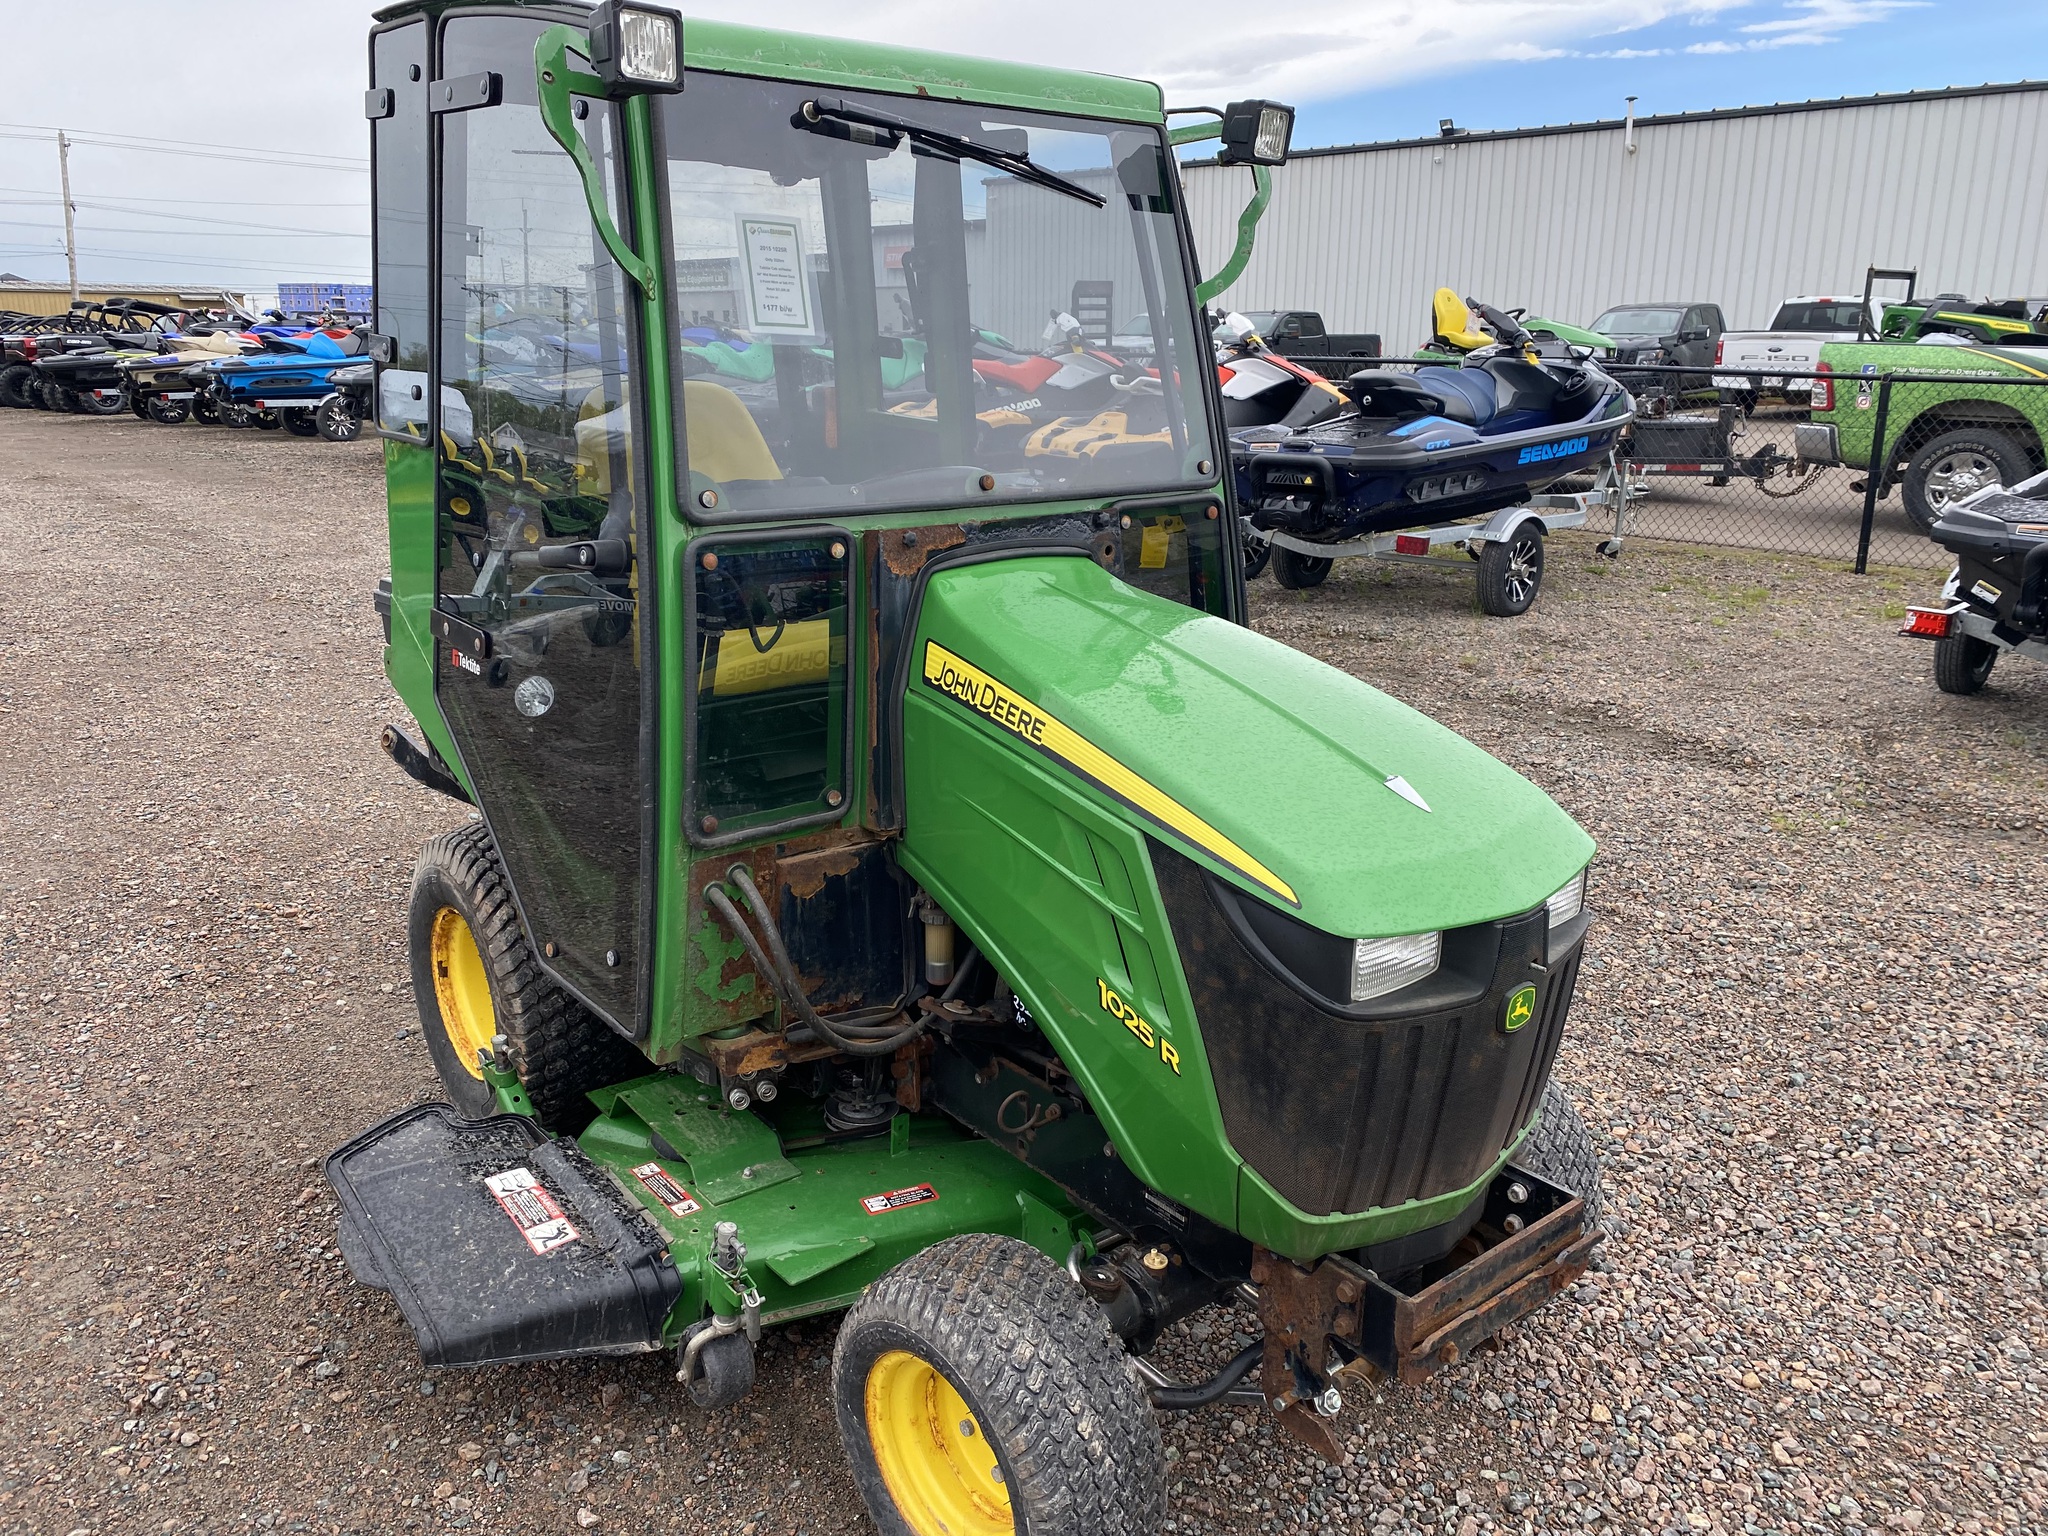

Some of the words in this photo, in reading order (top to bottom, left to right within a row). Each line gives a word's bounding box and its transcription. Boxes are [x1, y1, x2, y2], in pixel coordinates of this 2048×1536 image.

[763, 303, 778, 312] $177
[1740, 354, 1810, 362] F-150
[1426, 439, 1452, 450] GTX
[458, 651, 481, 676] Tektite
[933, 660, 979, 705] JOHN
[979, 682, 1047, 743] DEERE
[1096, 976, 1155, 1049] 1025
[1159, 1036, 1182, 1077] R
[540, 1194, 560, 1216] DANGER
